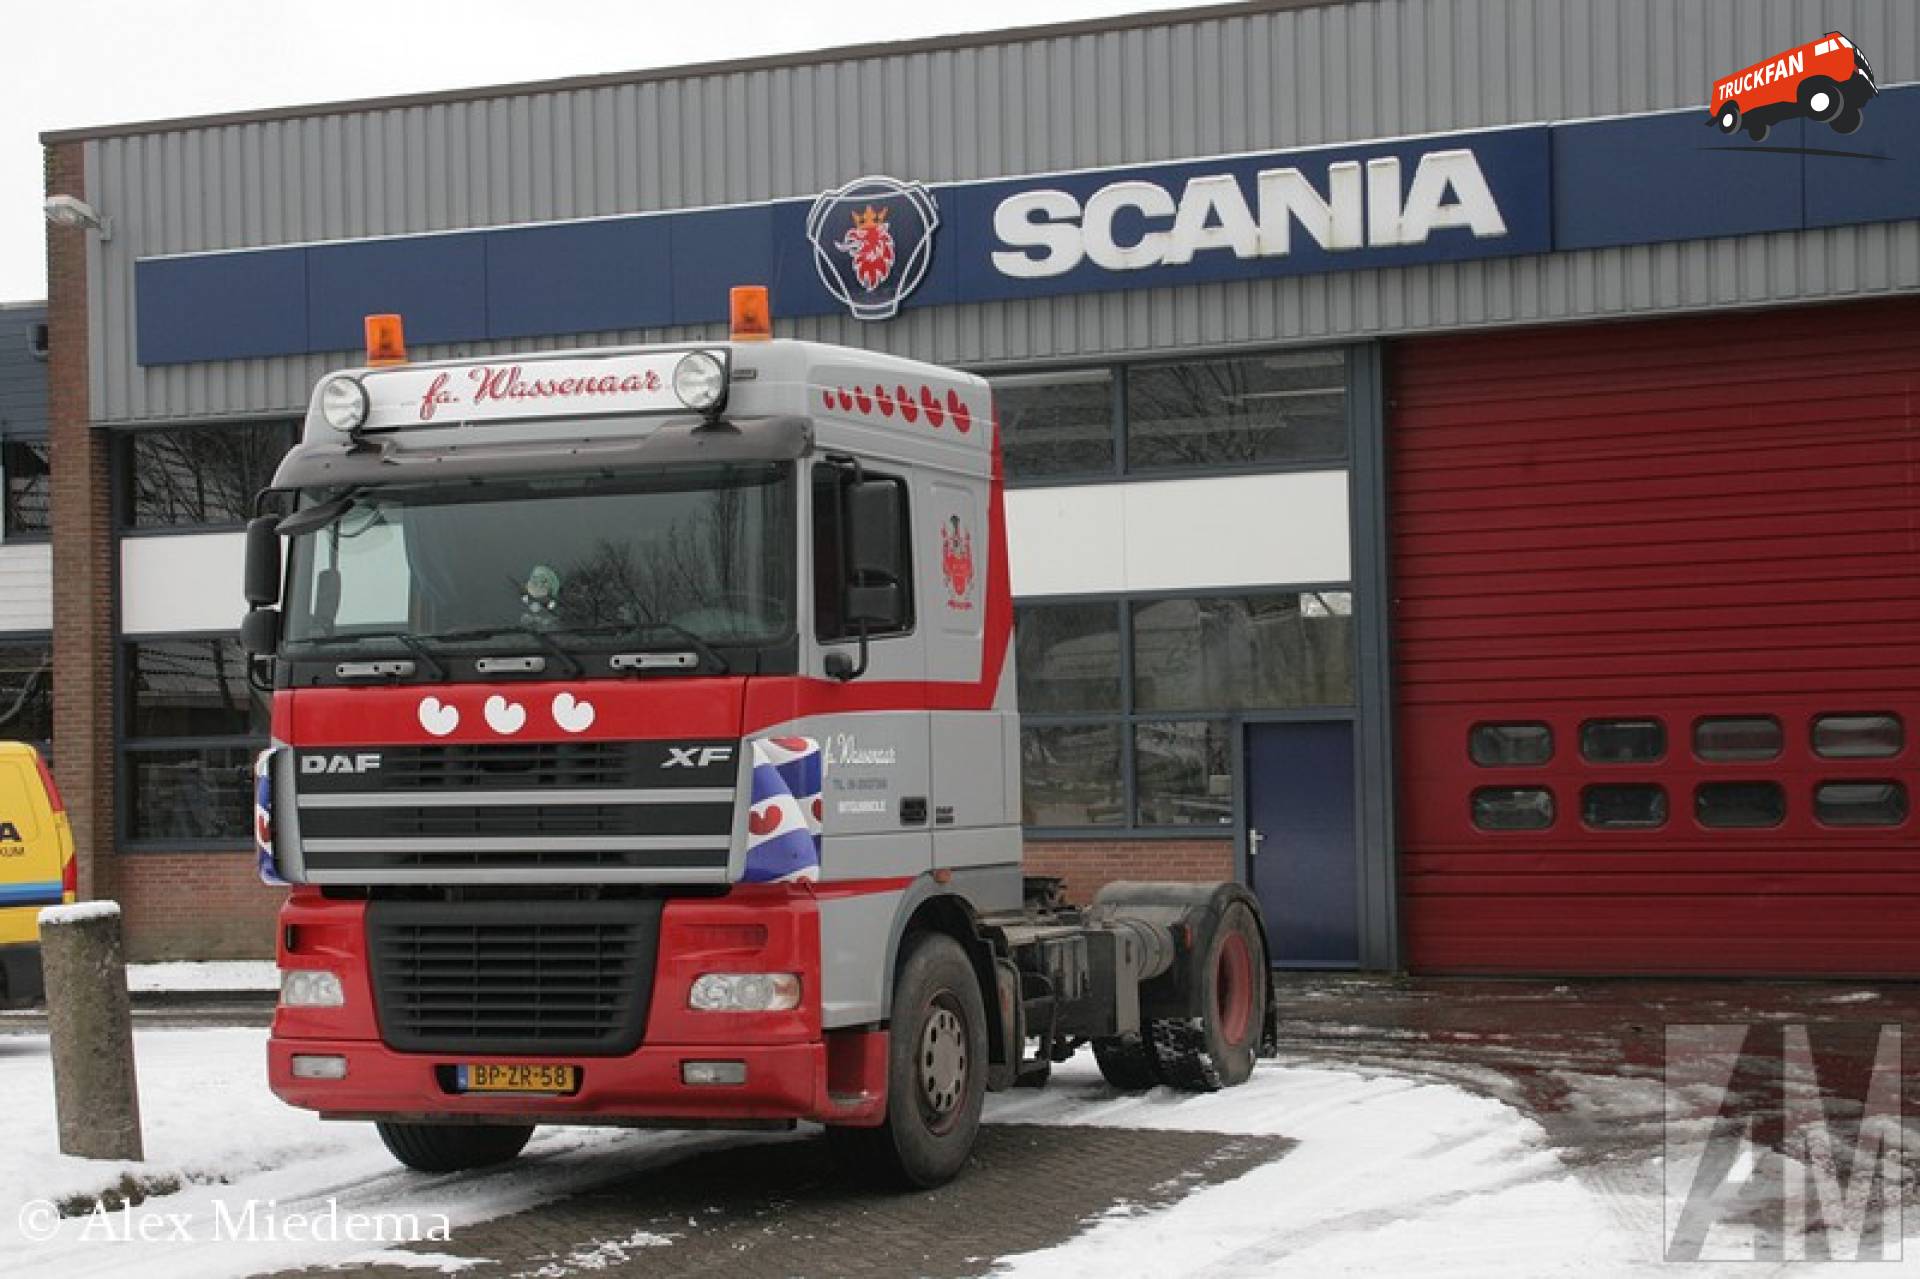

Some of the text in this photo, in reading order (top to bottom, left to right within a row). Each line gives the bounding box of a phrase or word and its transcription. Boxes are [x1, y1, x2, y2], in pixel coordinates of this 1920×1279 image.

[991, 148, 1508, 279] SCANIA
[301, 752, 383, 775] DAF
[661, 746, 734, 768] XF
[474, 1064, 567, 1088] BP-ZR-58
